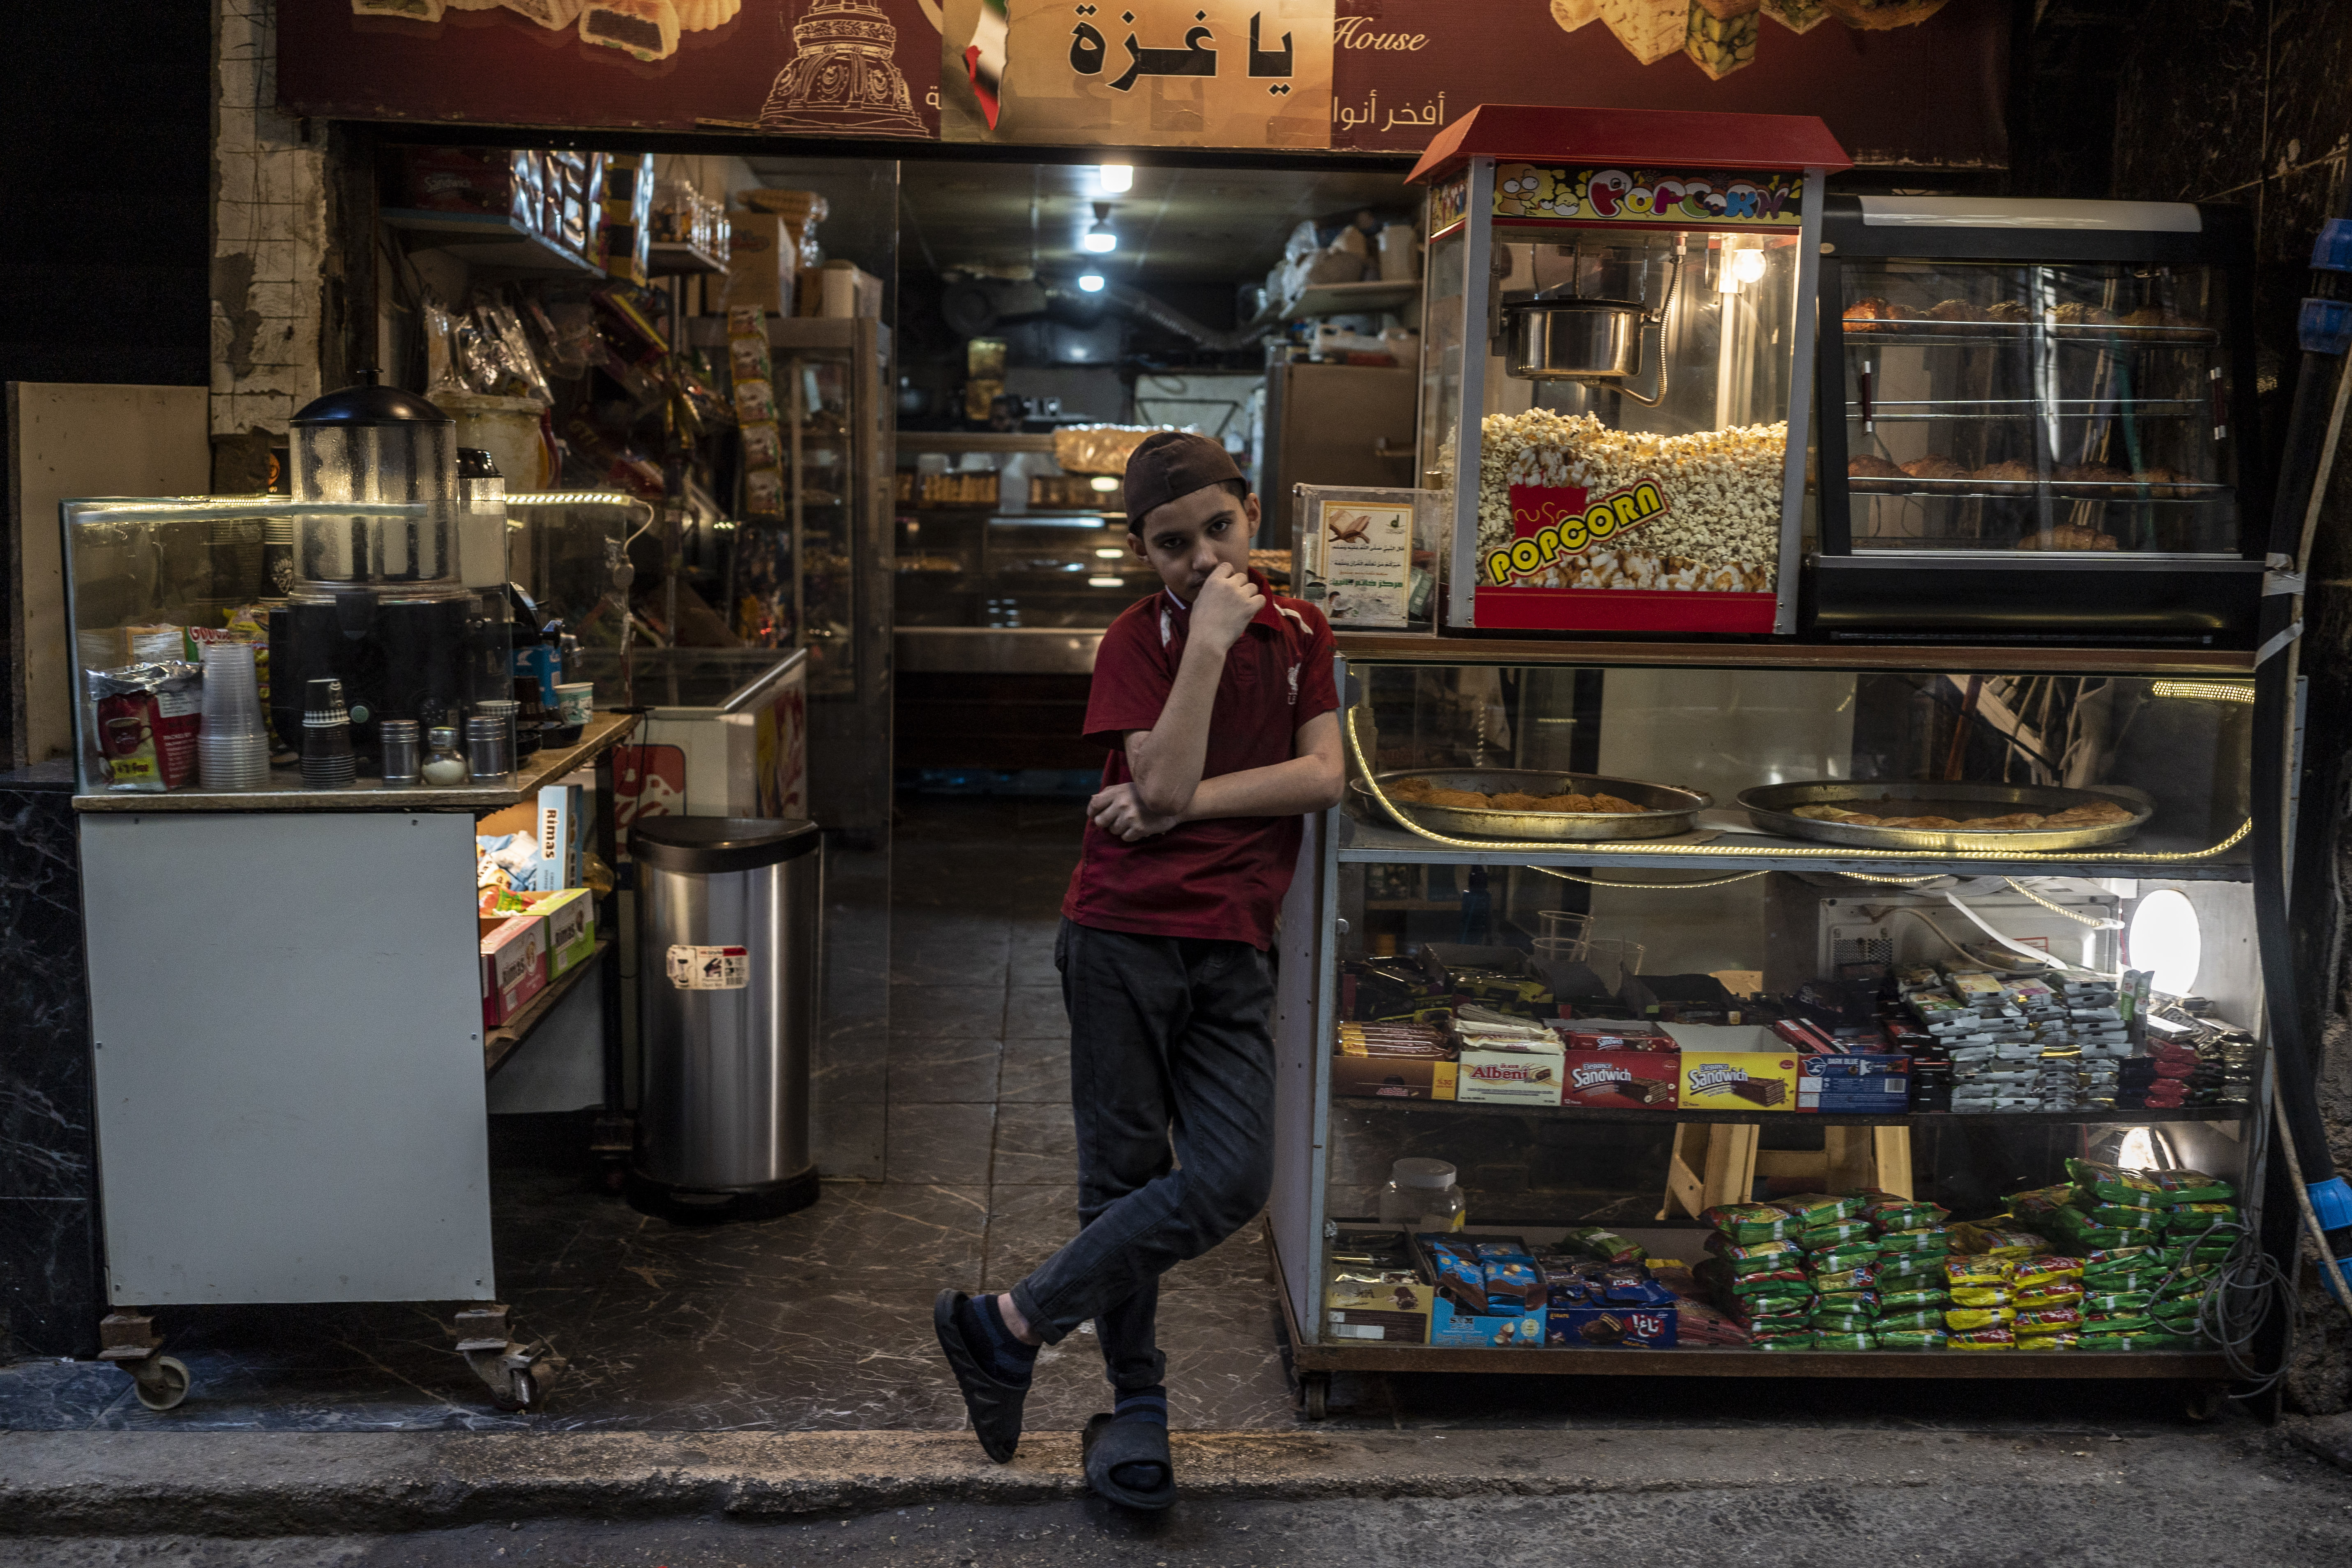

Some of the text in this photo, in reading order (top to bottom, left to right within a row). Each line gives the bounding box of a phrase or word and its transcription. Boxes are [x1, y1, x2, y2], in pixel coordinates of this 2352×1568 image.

[1070, 3, 1294, 97] يا غزة
[1334, 16, 1430, 51] House
[1333, 90, 1445, 131] أفخر أنوا
[1488, 483, 1664, 585] POPCORN
[546, 809, 559, 858] Rimas
[1470, 1064, 1530, 1081] Albeni
[1571, 1067, 1632, 1088] Sandwich
[1688, 1067, 1749, 1090] Sandwich
